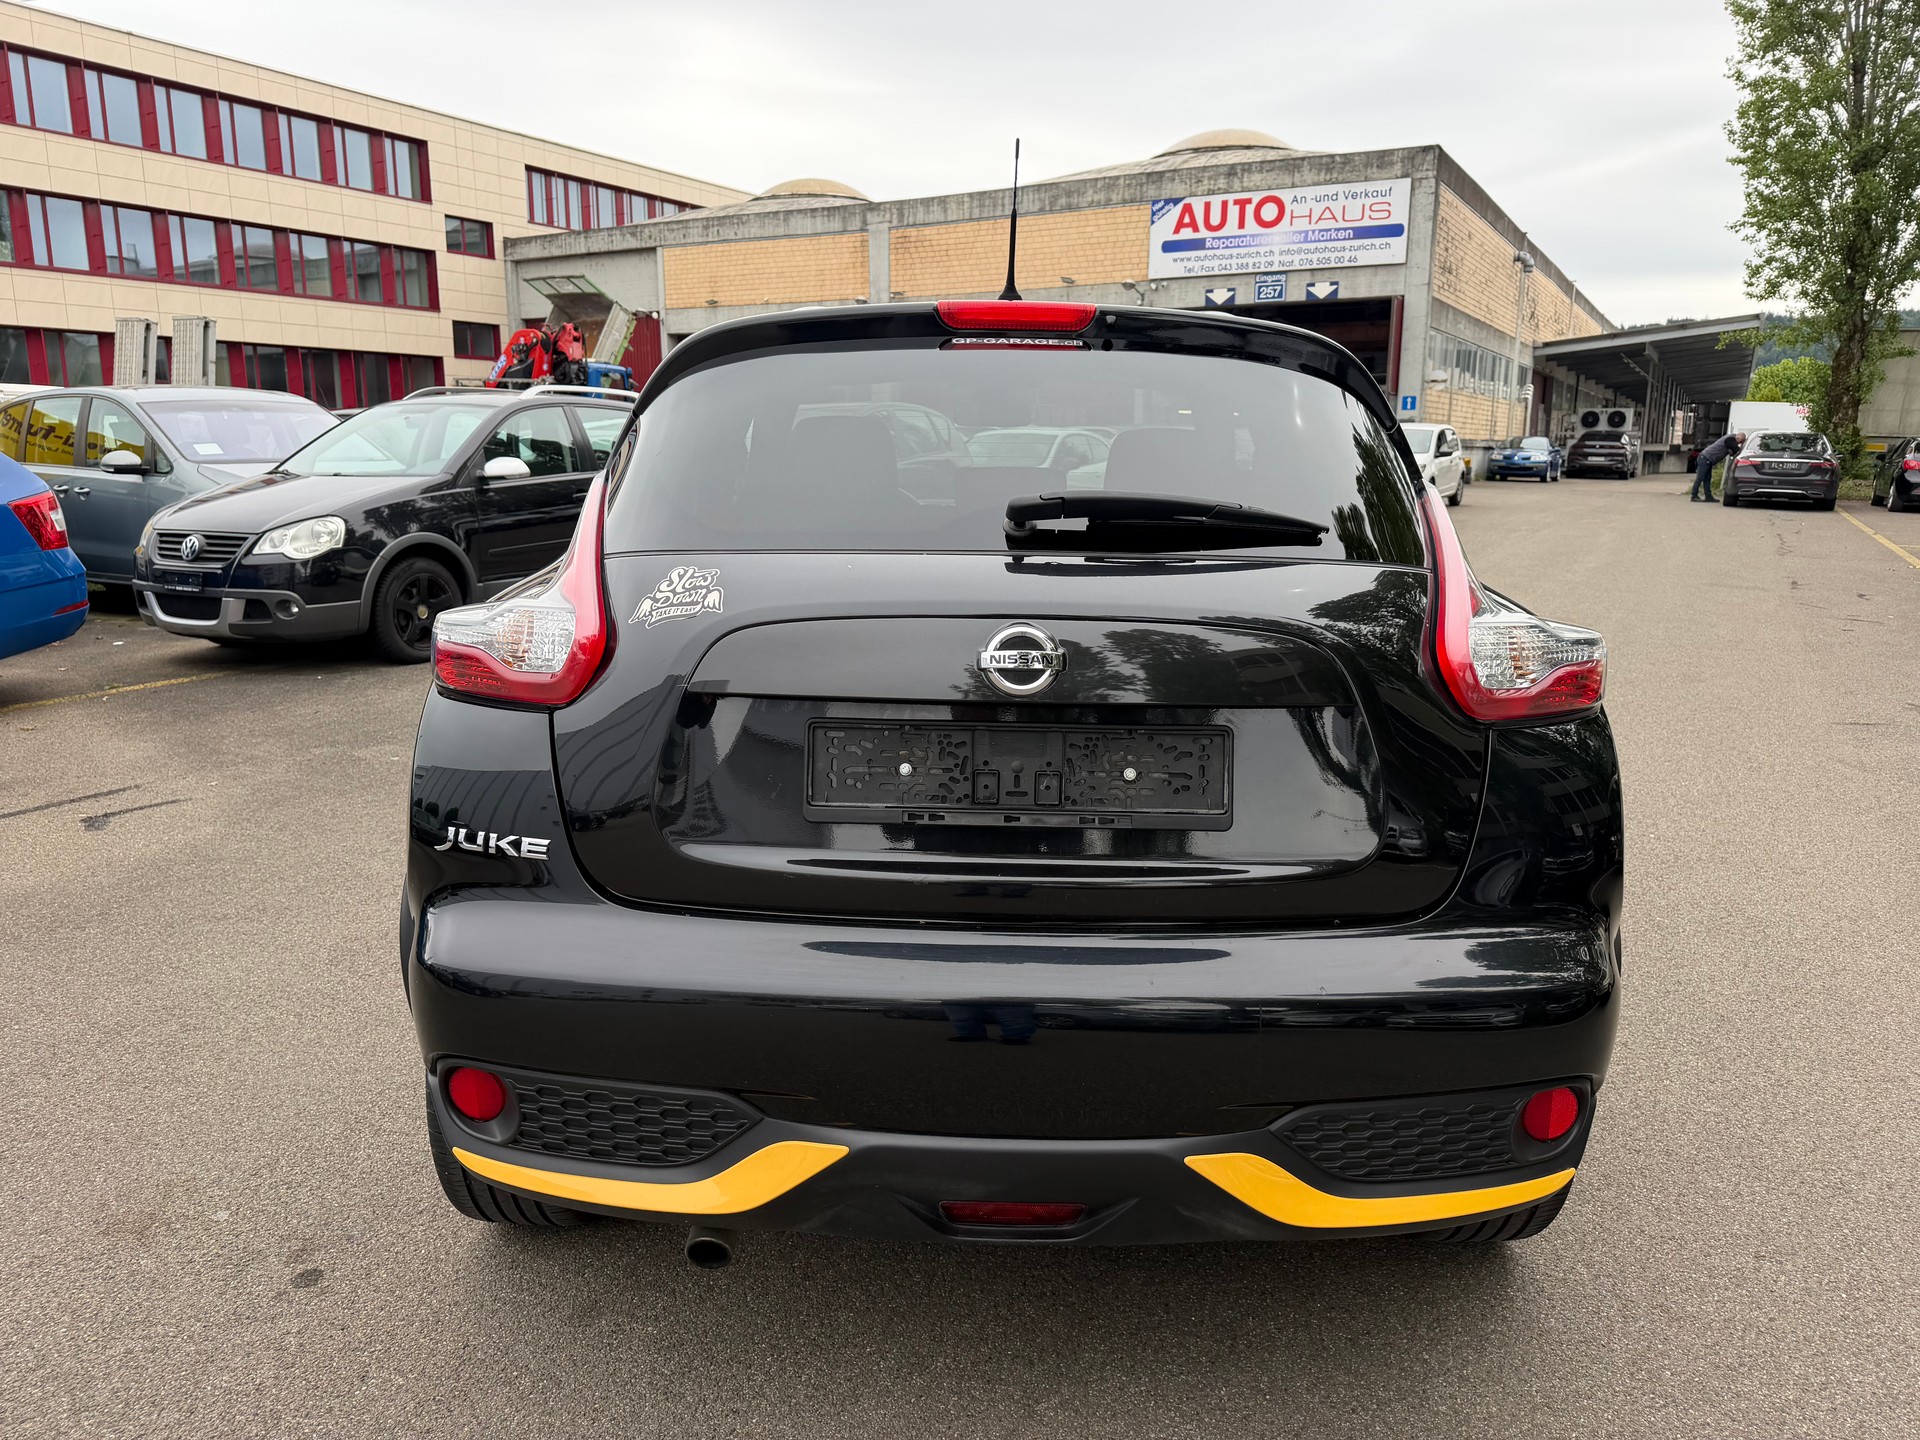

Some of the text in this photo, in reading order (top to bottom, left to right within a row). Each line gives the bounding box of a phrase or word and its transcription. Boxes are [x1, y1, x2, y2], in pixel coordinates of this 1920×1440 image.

[1290, 194, 1307, 205] An
[1343, 186, 1393, 200] Verkauf
[1172, 195, 1286, 235] AUTO
[1289, 201, 1392, 226] HAUS
[1307, 229, 1354, 242] Marken
[1172, 241, 1391, 263] www.autohaus-zurich.ch info@autohaus-zurich.ch
[1217, 263, 1233, 273] 043
[1298, 257, 1314, 267] 076
[1255, 272, 1287, 283] Eingang
[1259, 286, 1282, 299] 257
[952, 337, 1083, 346] GP-GARAGE.ch
[659, 568, 716, 592] Slow
[652, 588, 707, 608] Down
[654, 608, 673, 619] TAKE
[680, 606, 698, 614] EASY
[989, 653, 1054, 666] NISSAN
[433, 826, 551, 860] JUKE
